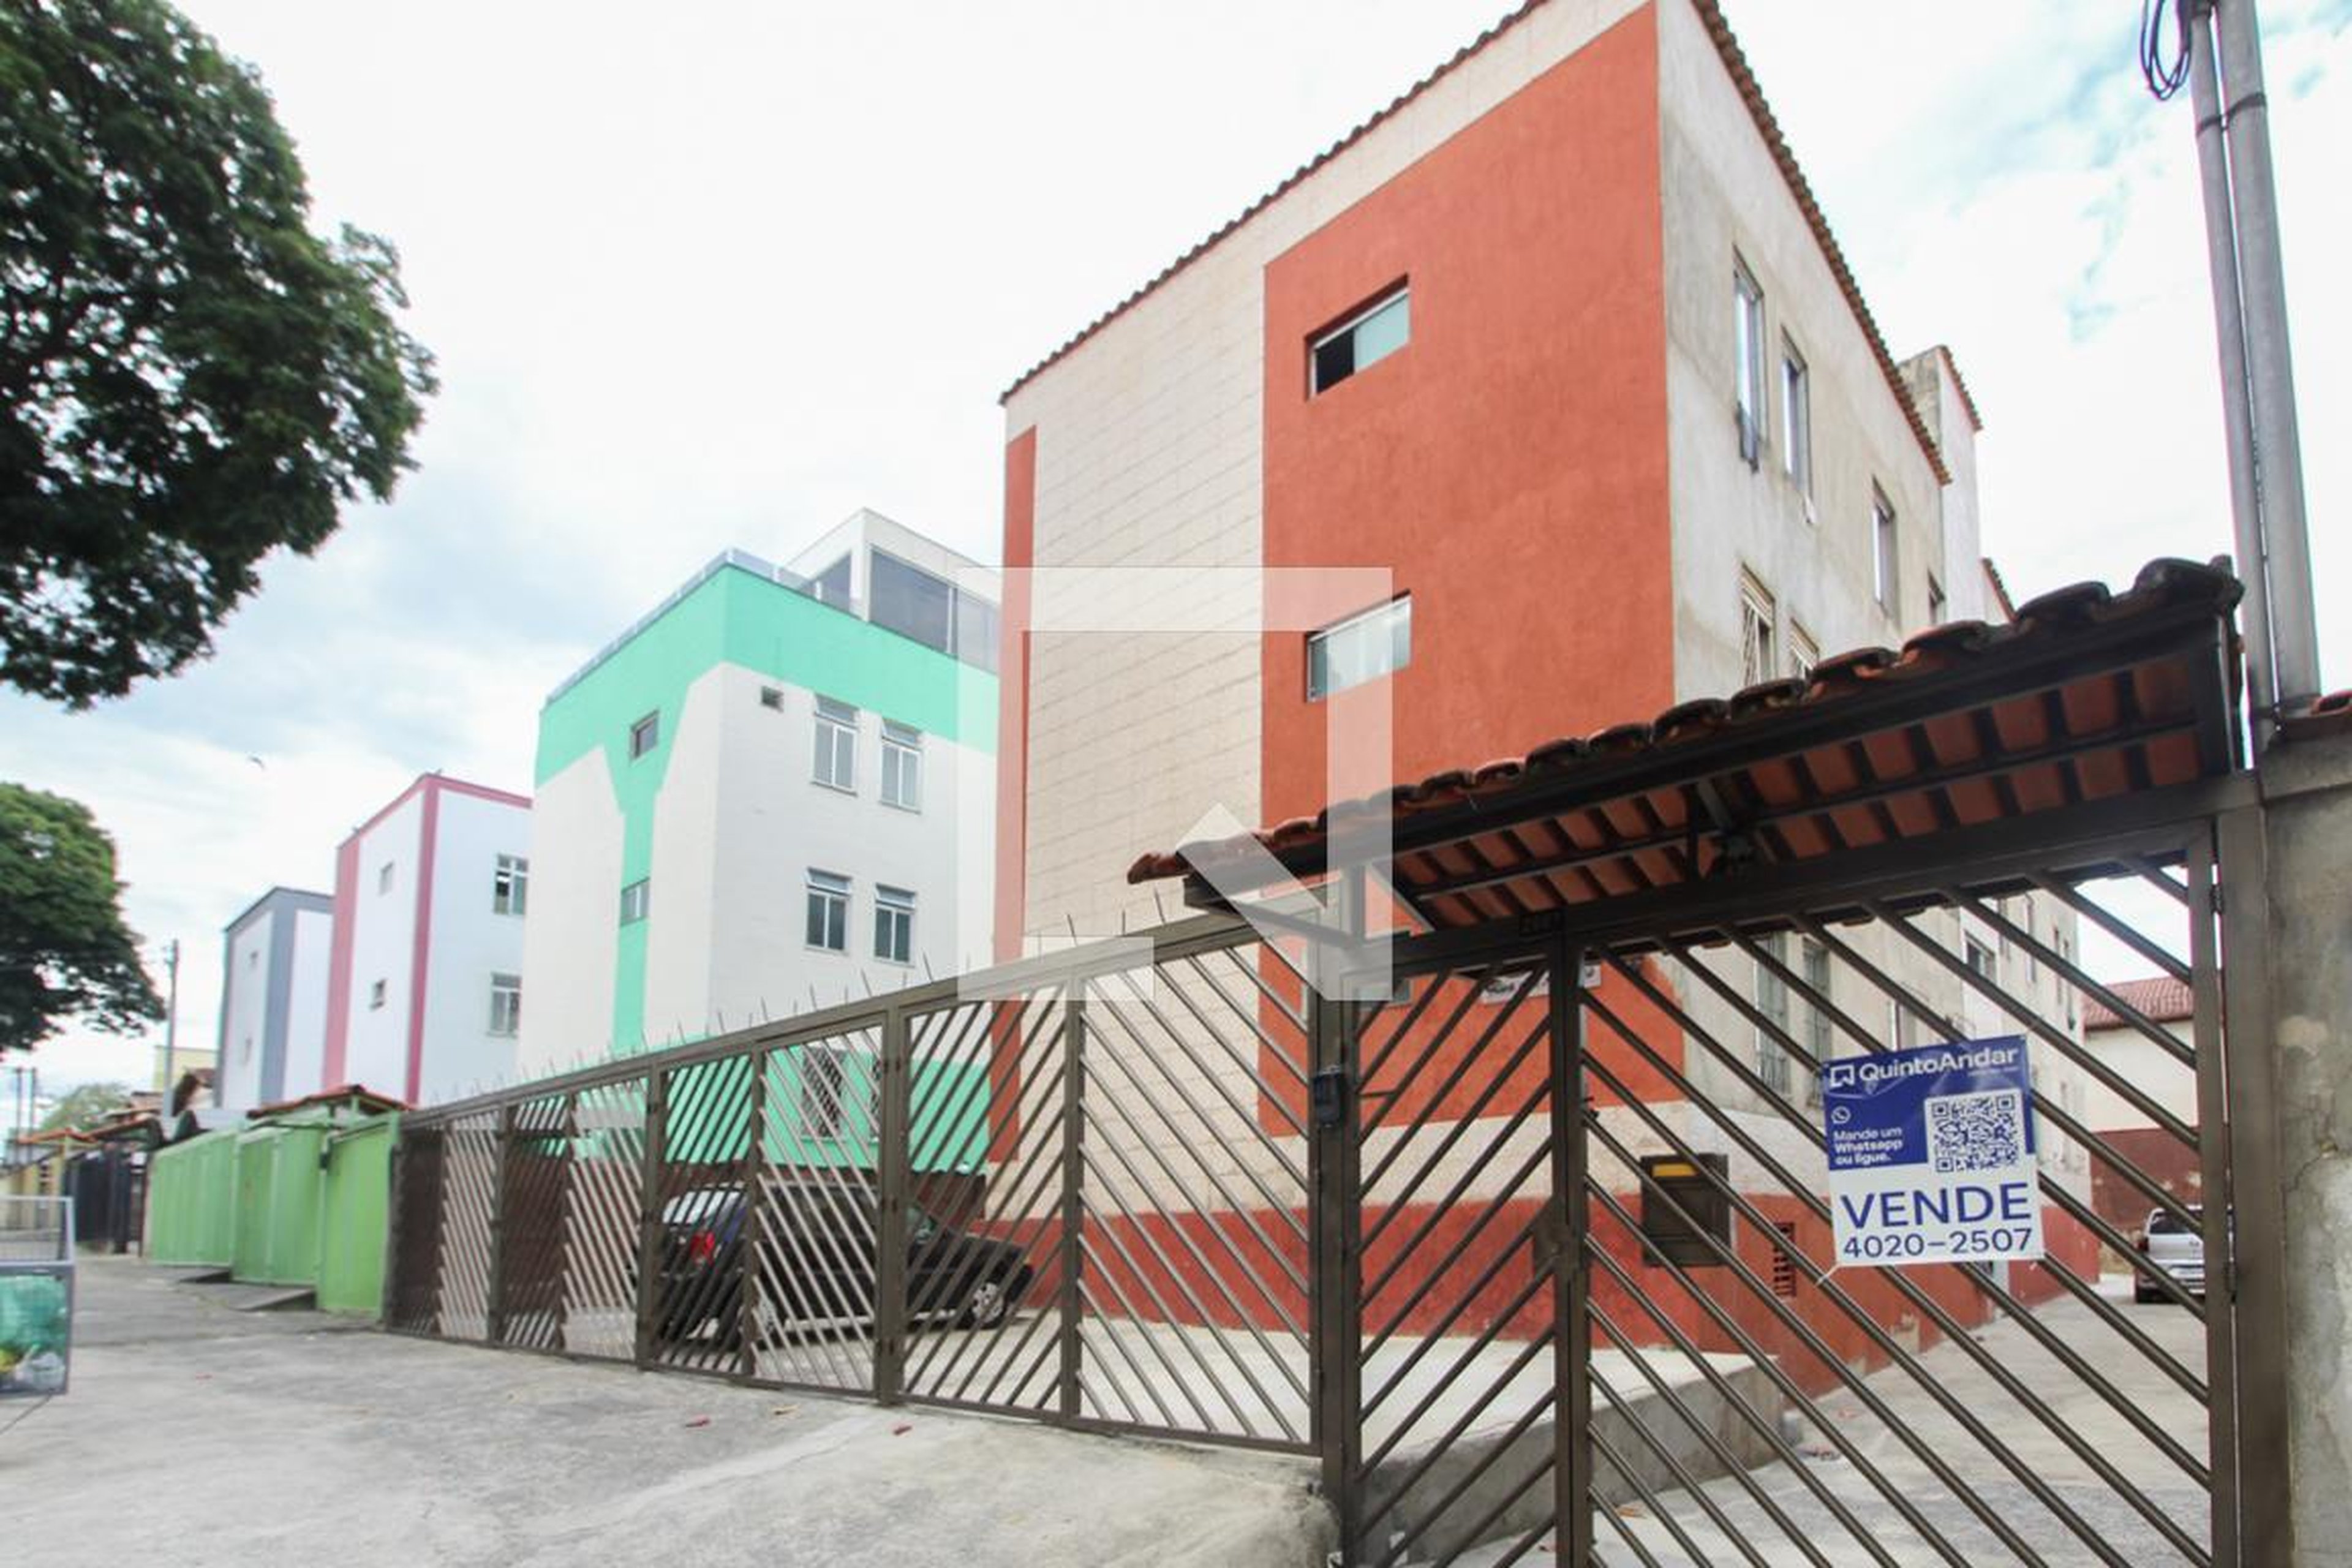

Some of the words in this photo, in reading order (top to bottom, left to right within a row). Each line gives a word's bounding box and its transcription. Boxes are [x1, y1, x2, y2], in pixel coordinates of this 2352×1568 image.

[1859, 1047, 2019, 1082] QuintoAndar
[1880, 1127, 1902, 1139] um
[1835, 1140, 1903, 1154] Whatsapp
[1836, 1155, 1853, 1165] ou
[1841, 1183, 2030, 1229] VENDE
[1844, 1228, 2032, 1258] 4020-2507
